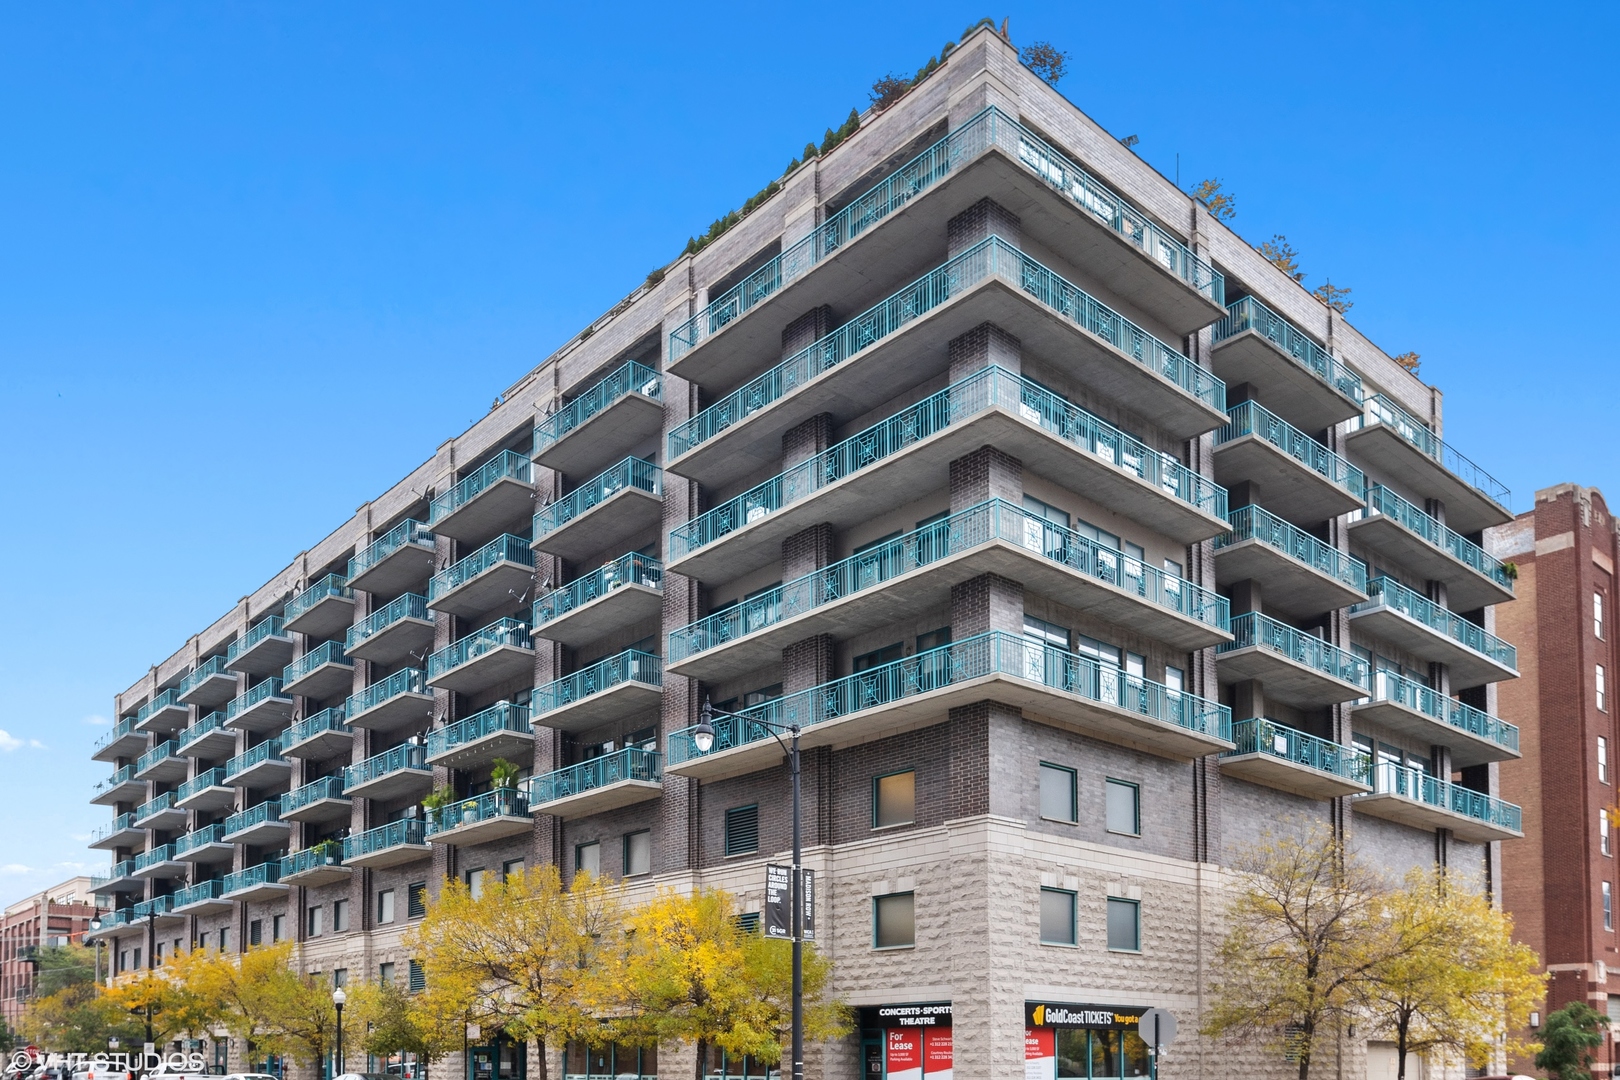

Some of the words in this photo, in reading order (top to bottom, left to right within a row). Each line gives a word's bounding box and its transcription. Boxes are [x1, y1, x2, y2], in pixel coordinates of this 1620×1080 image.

[768, 875, 788, 883] CIRCLES
[768, 882, 787, 890] AROUND
[879, 1007, 920, 1016] CONCERTS
[899, 1017, 935, 1025] THEATRE
[1114, 1013, 1124, 1023] You
[889, 1032, 903, 1041] For
[889, 1041, 913, 1050] Lease
